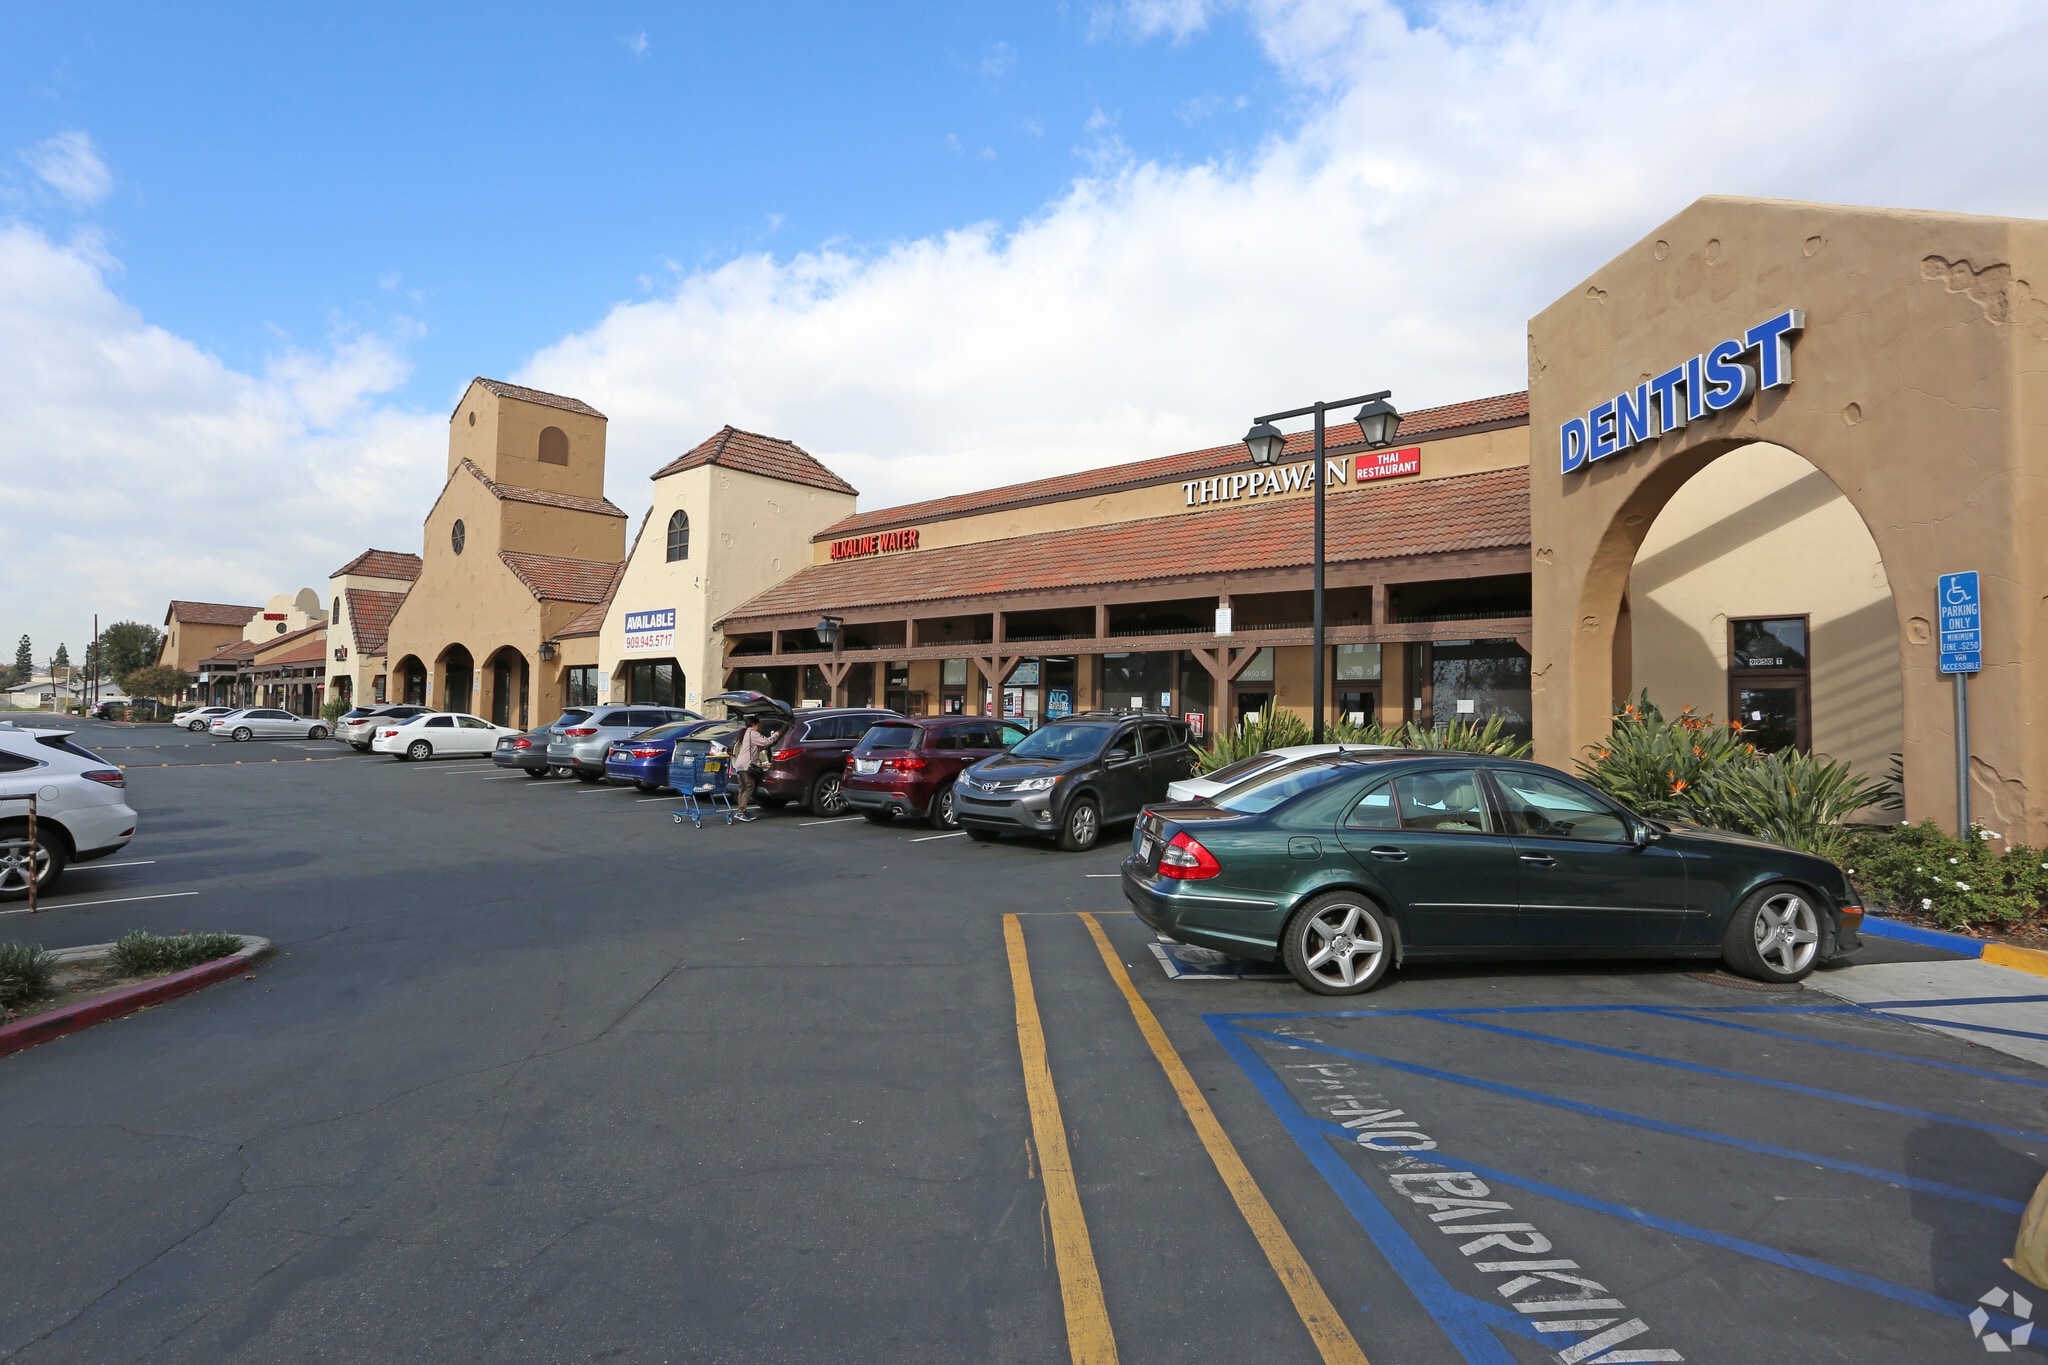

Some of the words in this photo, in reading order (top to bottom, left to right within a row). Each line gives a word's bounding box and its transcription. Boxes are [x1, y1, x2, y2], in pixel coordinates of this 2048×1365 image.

[1560, 309, 1803, 475] DENTIST
[1377, 452, 1399, 465] THAI
[1357, 460, 1417, 479] RESTAURANT
[830, 535, 878, 560] ALKALINE
[880, 528, 918, 552] WATER
[1942, 603, 1977, 618] PARKING
[626, 612, 674, 630] AVAILABLE
[1948, 617, 1971, 630] ONLY
[626, 633, 673, 649] 909.945.5717
[1947, 632, 1974, 642] MINIMUM
[1943, 643, 1957, 652] FINE
[1942, 661, 1980, 671] ACCESSIBLE
[1049, 692, 1068, 703] NO
[1330, 1108, 1438, 1152] NO
[1390, 1171, 1686, 1365] PARKIN
